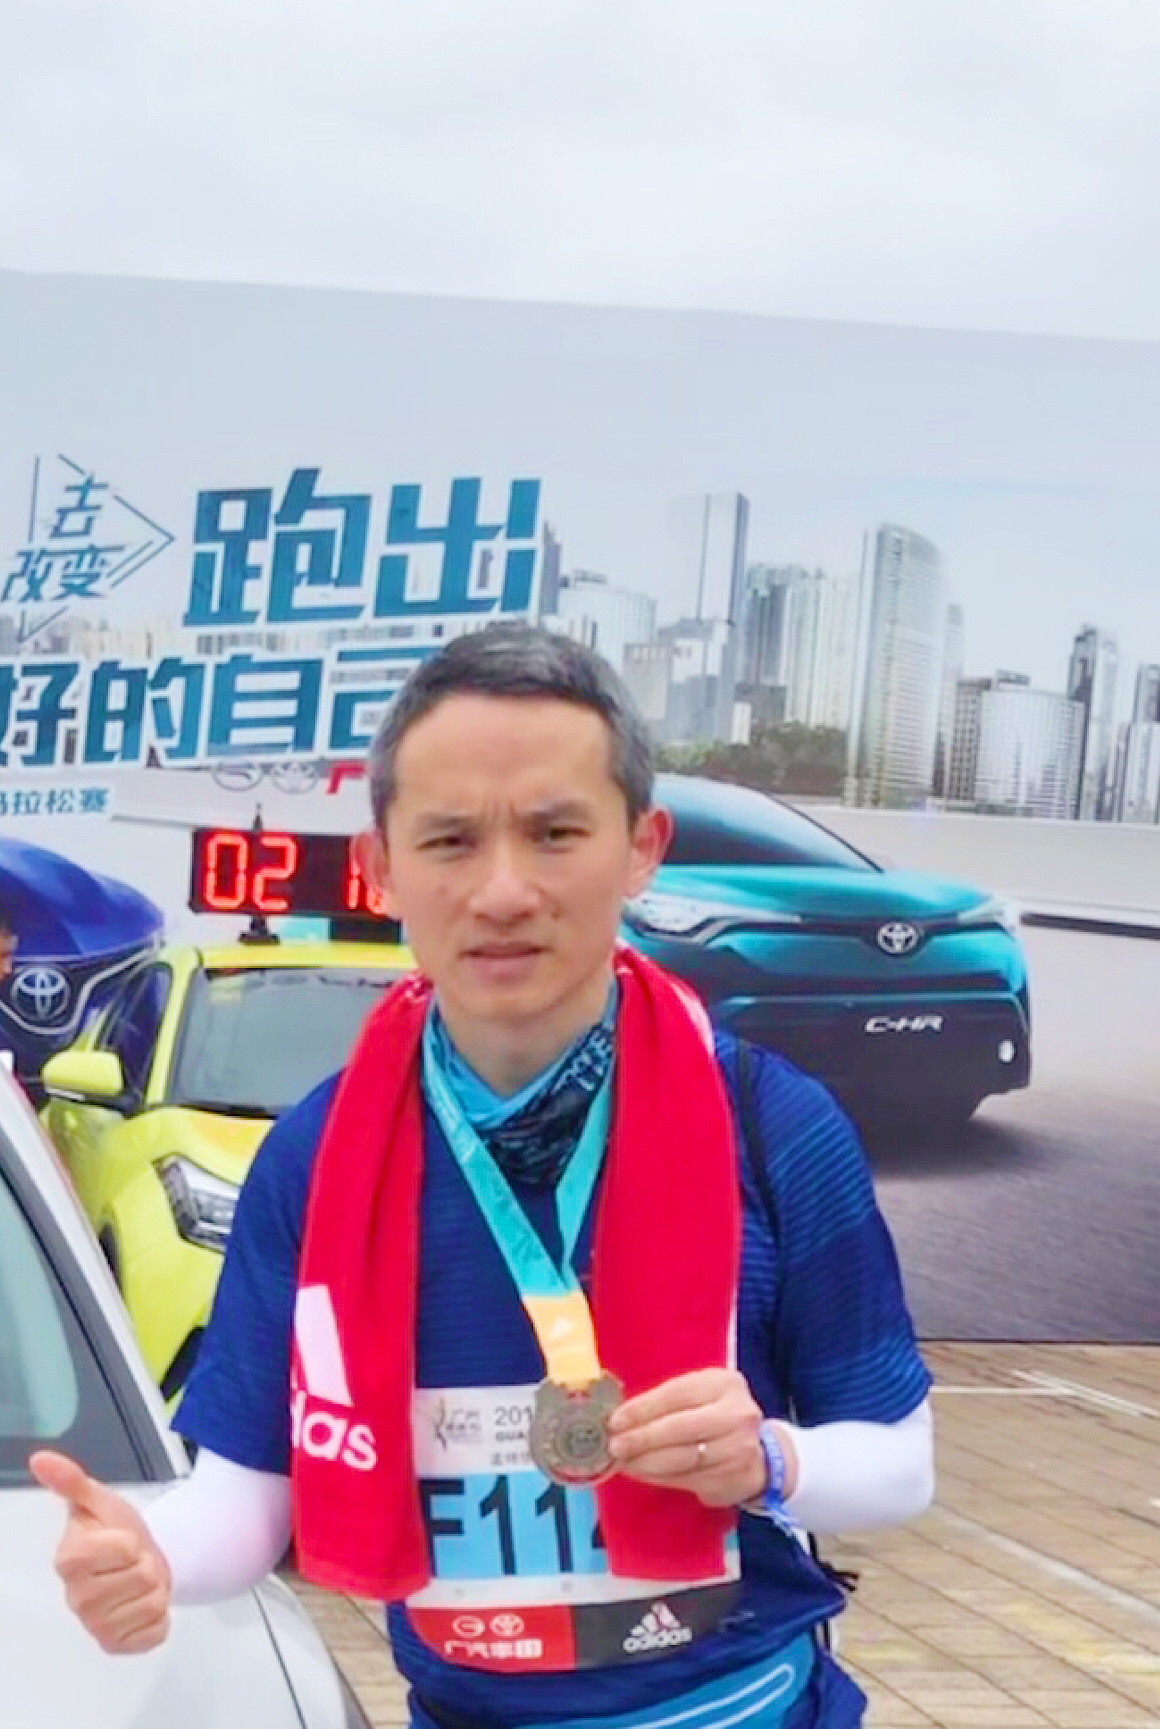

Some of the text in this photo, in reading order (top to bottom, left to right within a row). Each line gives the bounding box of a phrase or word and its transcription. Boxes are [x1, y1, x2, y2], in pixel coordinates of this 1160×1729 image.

[49, 471, 109, 540] 去
[0, 543, 126, 603] 改变
[183, 468, 541, 629] 跑出
[205, 832, 298, 911] 02
[865, 1014, 944, 1033] C-HR
[494, 1405, 534, 1427] 201
[418, 1473, 608, 1578] F11
[622, 1626, 693, 1653] adidas
